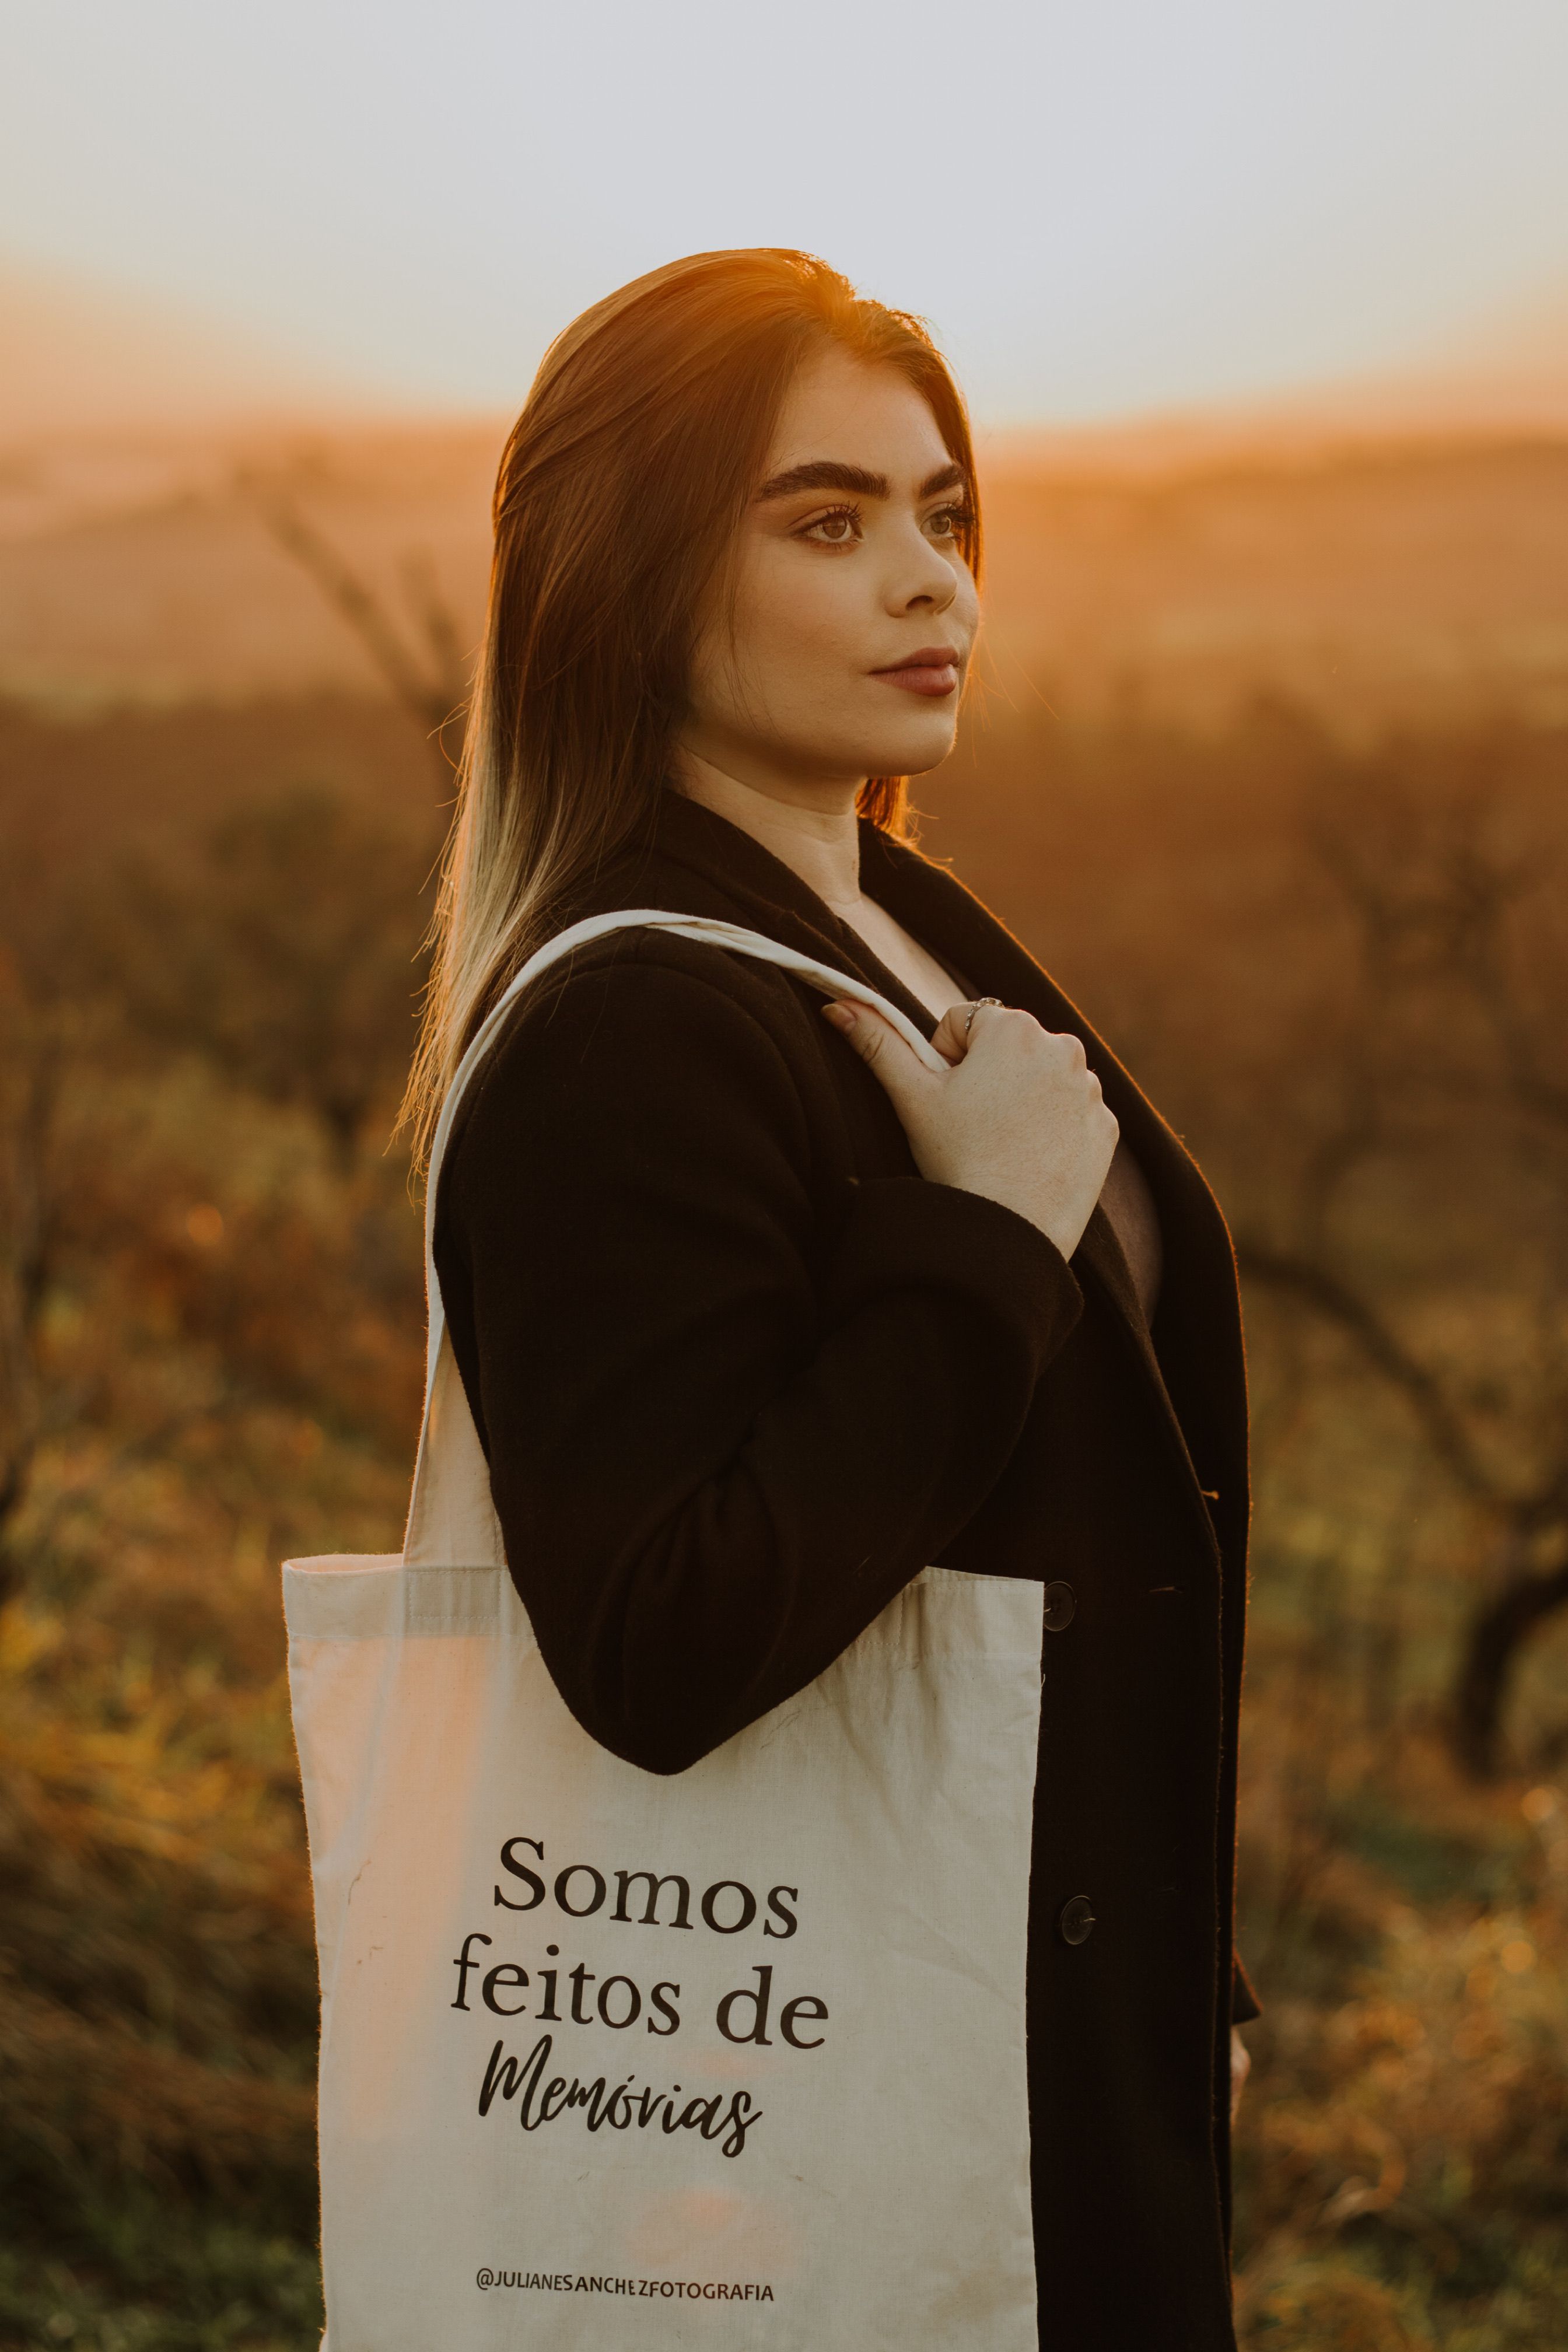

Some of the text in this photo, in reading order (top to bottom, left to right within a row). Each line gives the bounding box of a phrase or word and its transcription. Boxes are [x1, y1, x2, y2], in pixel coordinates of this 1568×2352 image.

[494, 1836, 799, 1939] Somos
[450, 1933, 829, 2050] feitos de
[478, 2034, 764, 2158] Memórias
[476, 2267, 775, 2302] @JULIANESANCHEZFOTOGRAFIA
